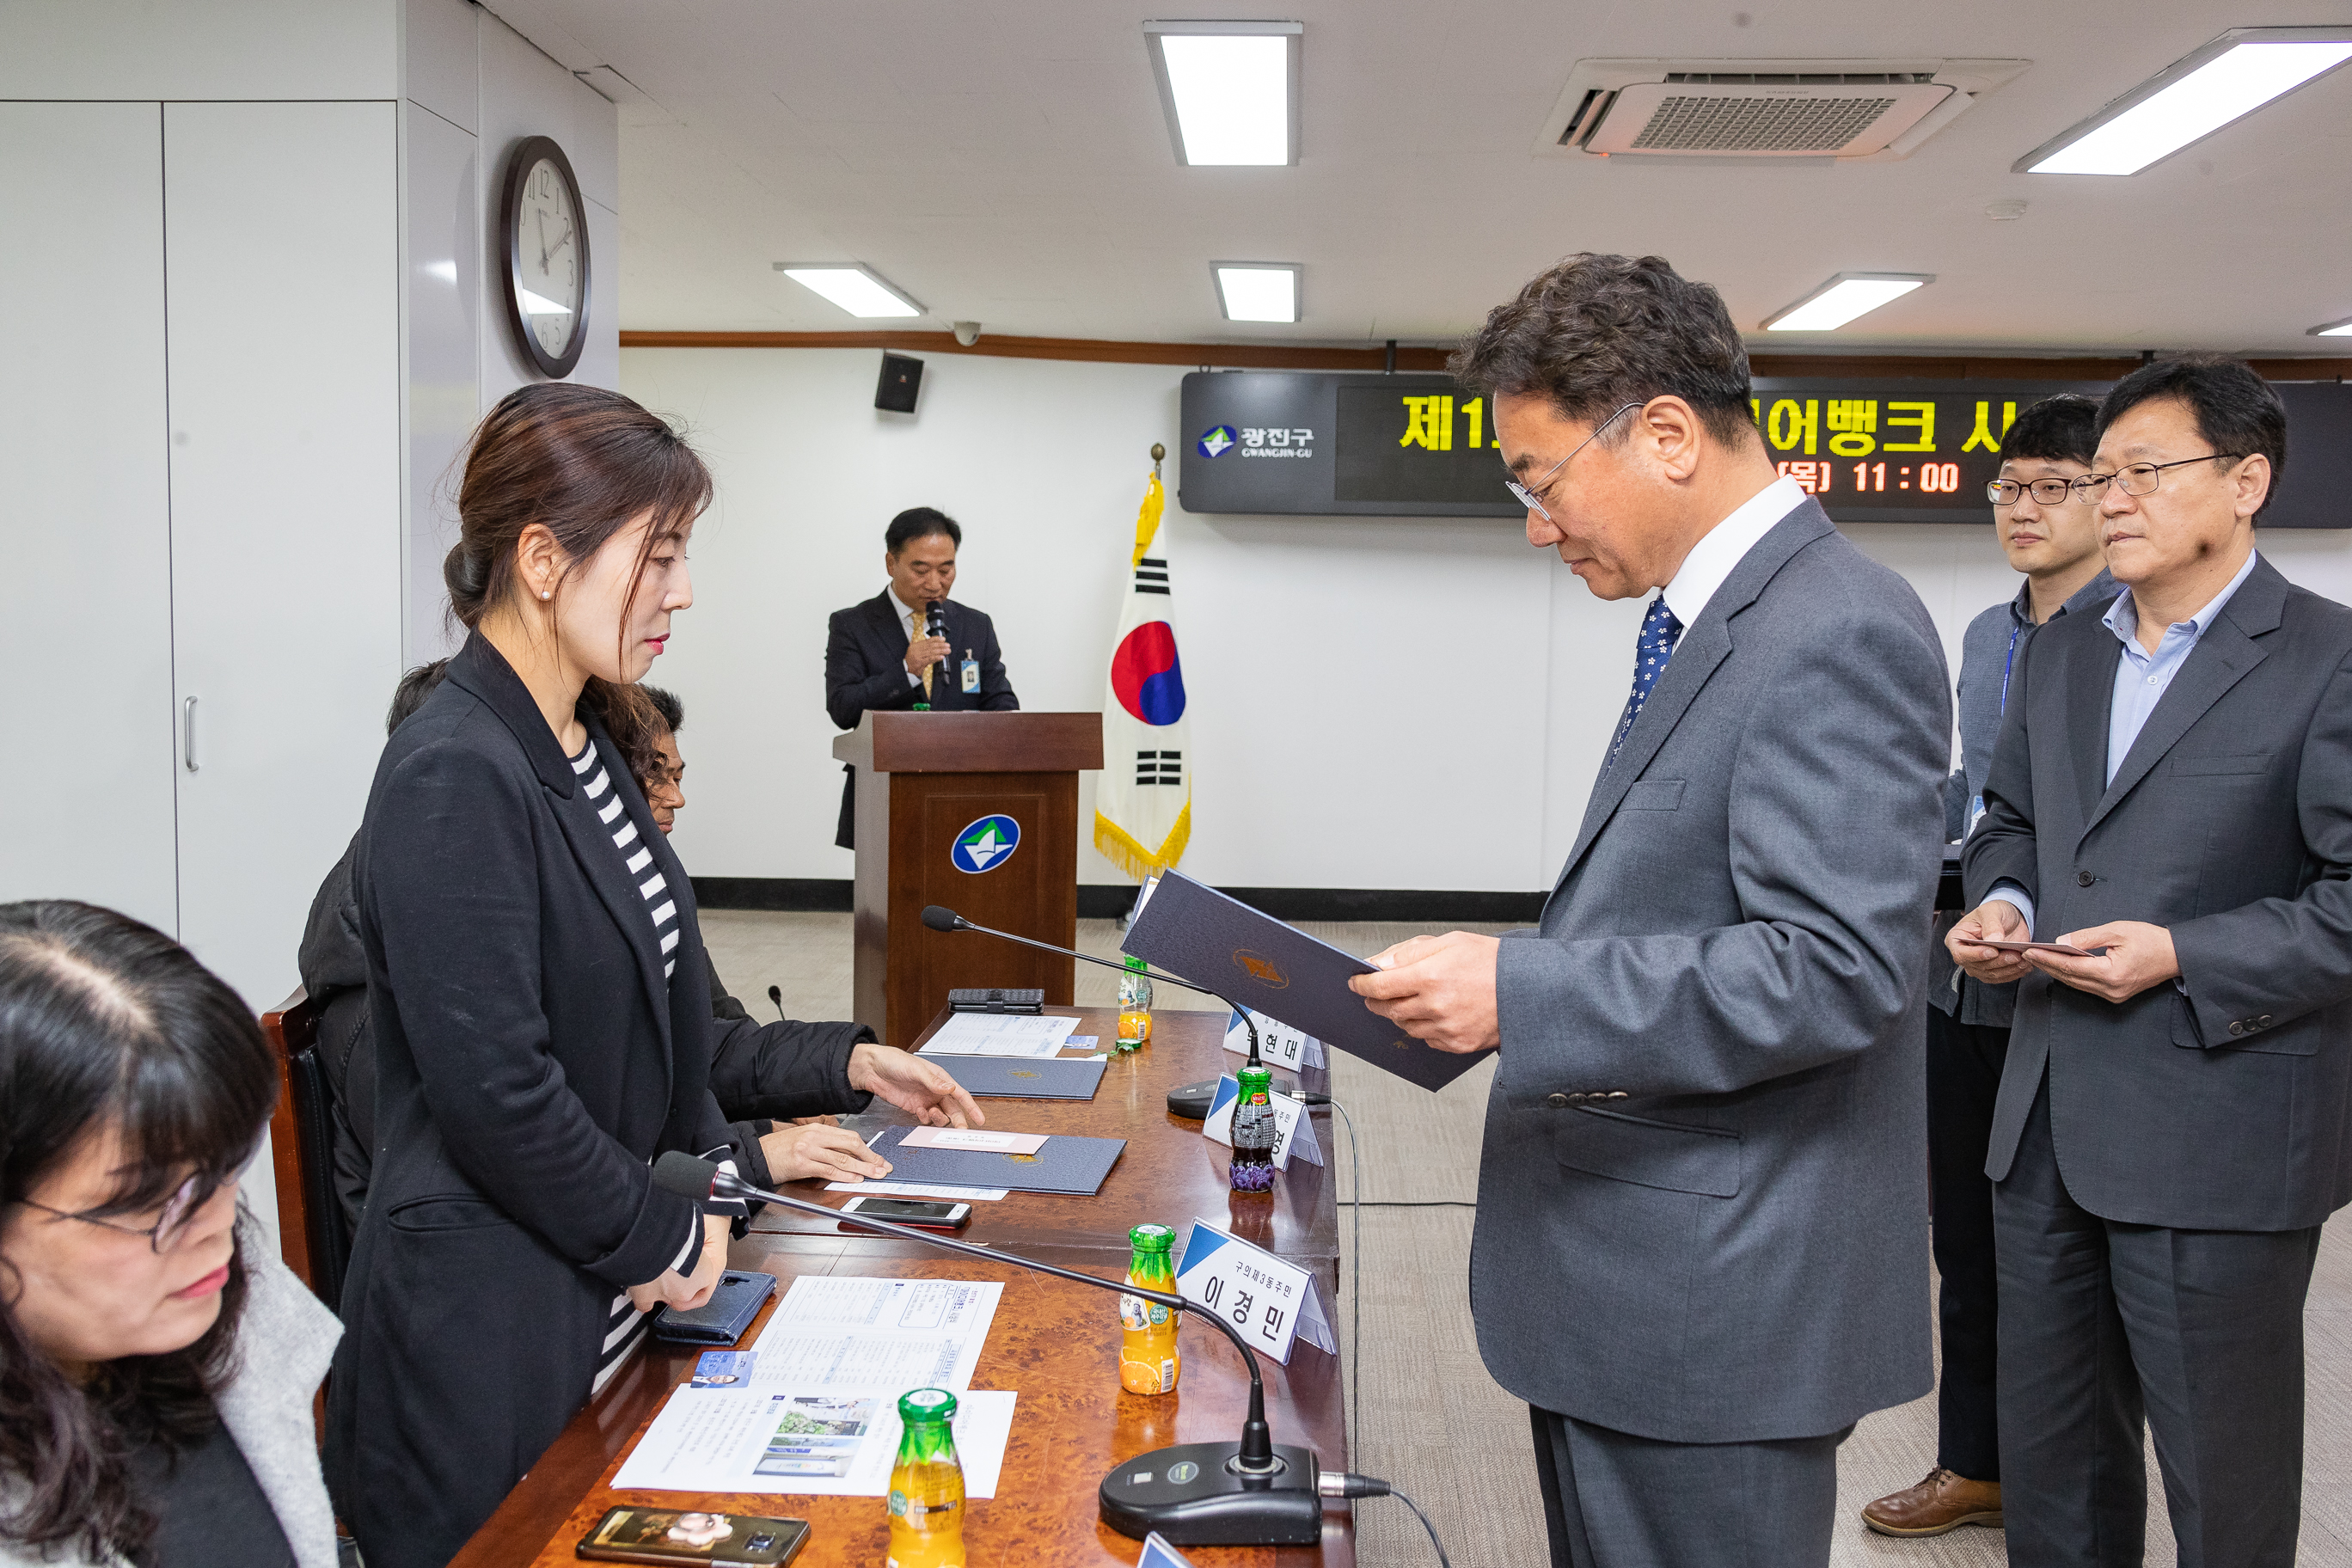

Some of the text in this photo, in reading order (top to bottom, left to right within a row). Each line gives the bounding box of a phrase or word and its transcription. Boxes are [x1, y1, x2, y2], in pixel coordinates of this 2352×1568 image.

[540, 168, 550, 199] 12
[567, 259, 574, 287] 3
[542, 322, 548, 349] 6
[1240, 427, 1314, 447] 광진구
[1399, 395, 1500, 451] 제1
[1753, 398, 1937, 457] 어뱅크
[1235, 1260, 1292, 1298] 구의제3동주민
[1204, 1276, 1284, 1342] 이경민
